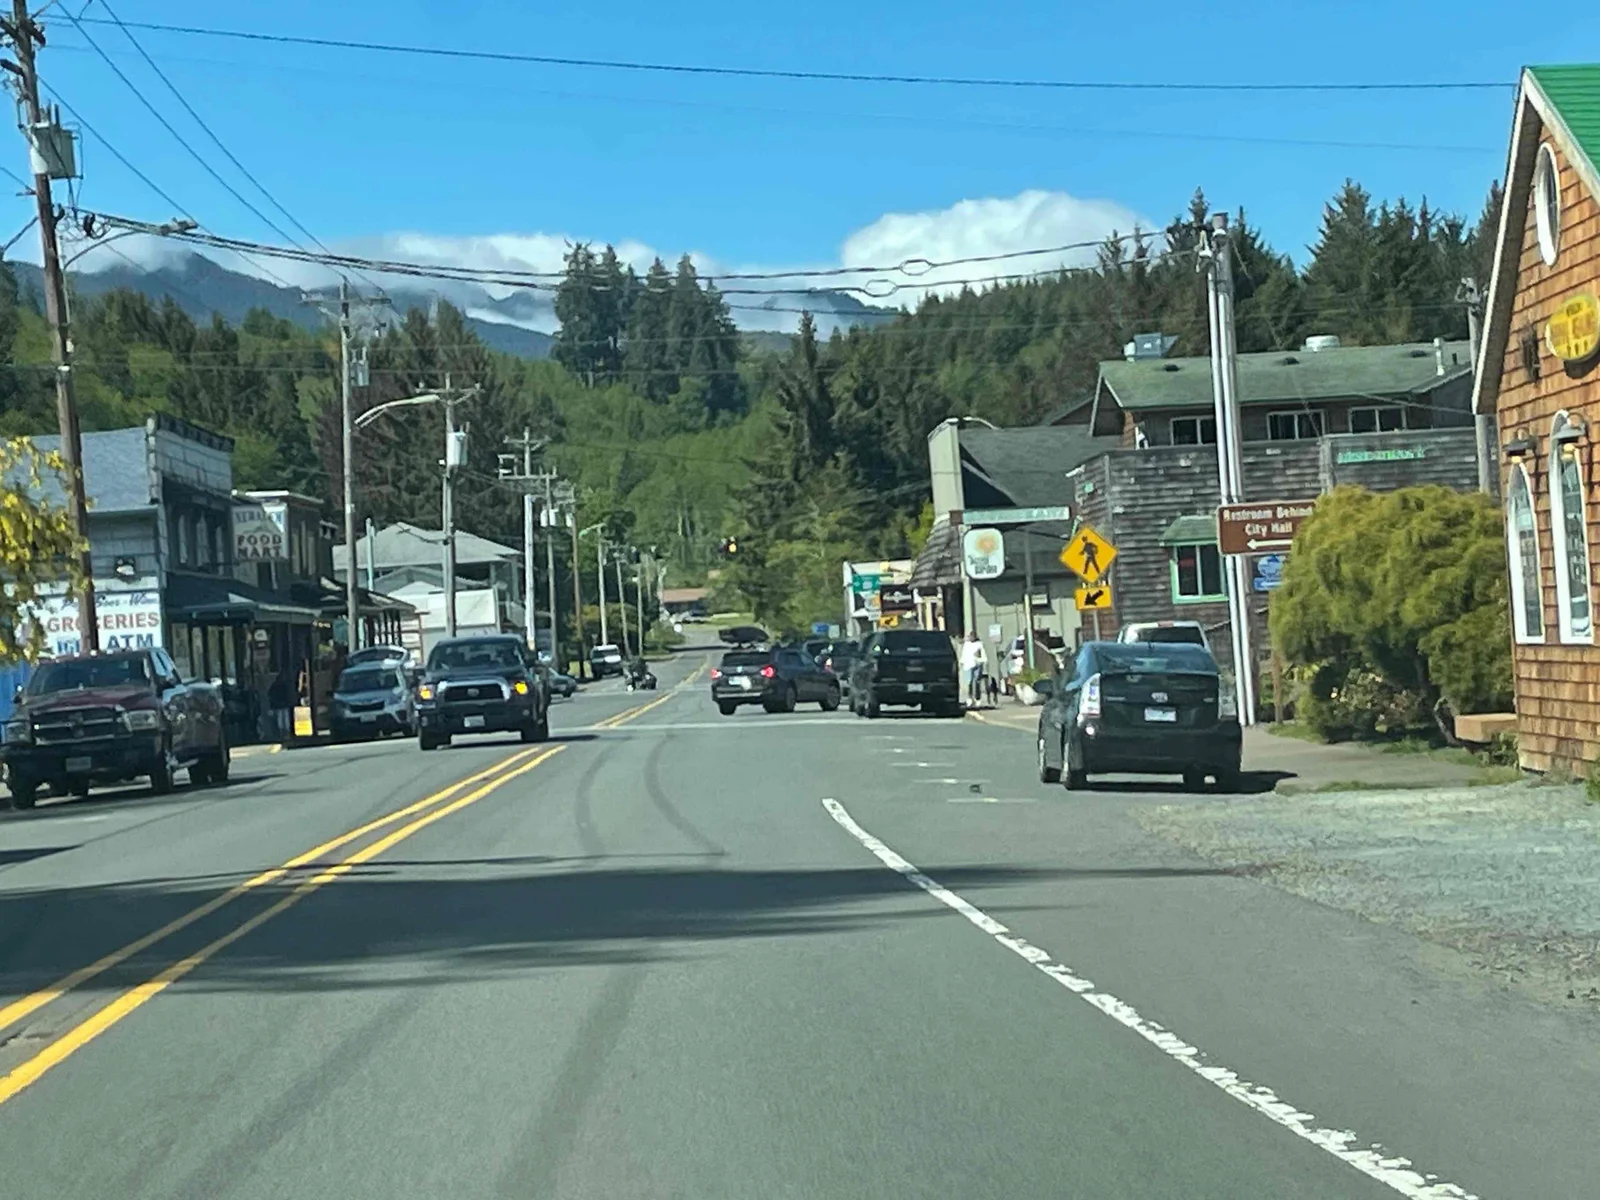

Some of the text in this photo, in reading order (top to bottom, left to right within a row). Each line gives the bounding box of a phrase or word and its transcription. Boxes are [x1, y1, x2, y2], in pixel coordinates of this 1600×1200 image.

[1222, 506, 1313, 521] Restroom Behind
[1245, 521, 1293, 537] City Hall
[237, 534, 282, 546] FOOD
[237, 546, 282, 559] MART
[46, 611, 160, 633] GRERIES
[106, 633, 154, 651] ATM
